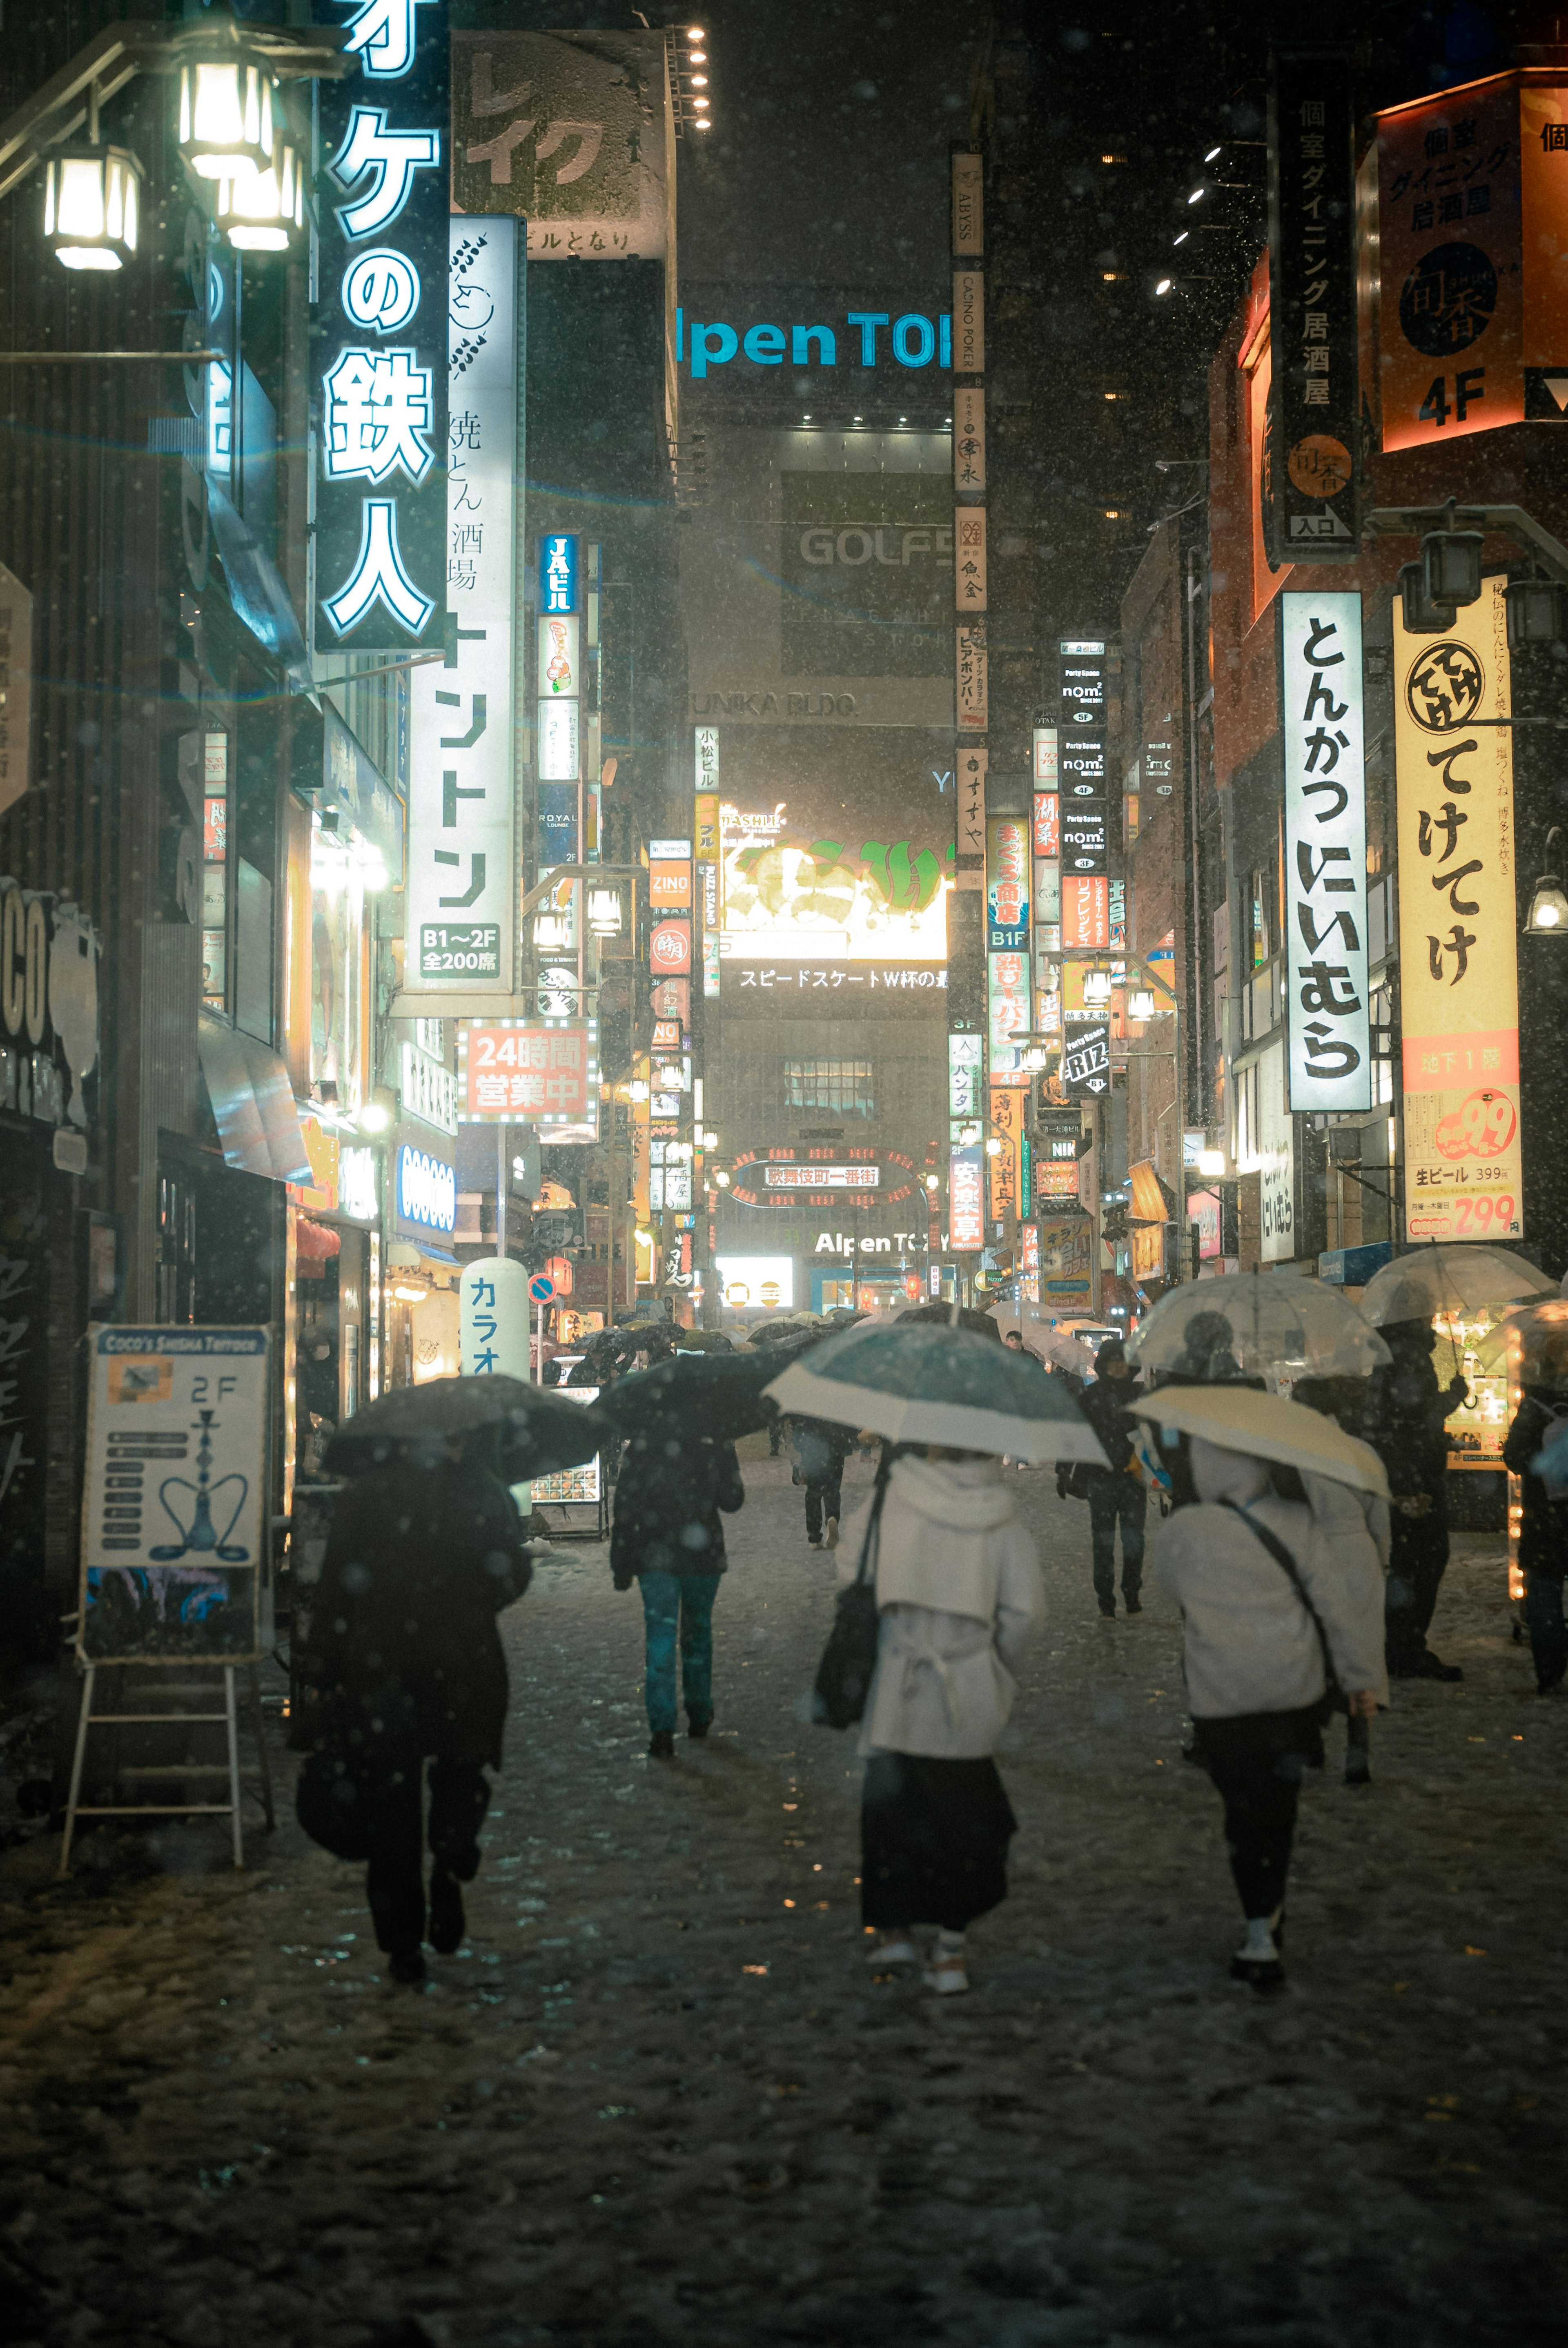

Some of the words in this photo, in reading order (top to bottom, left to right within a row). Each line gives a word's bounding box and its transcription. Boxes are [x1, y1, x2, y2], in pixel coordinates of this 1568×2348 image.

[1410, 184, 1490, 233] 居酒屋
[963, 277, 974, 325] CASINO
[963, 329, 974, 367] POKER
[1419, 366, 1486, 427] 4F
[1297, 522, 1335, 535] 入口
[961, 560, 983, 598] 魚金
[701, 730, 714, 787] 小松ビル
[566, 853, 576, 862] 2F
[1416, 738, 1483, 987] てけてけ
[653, 876, 688, 890] ZINO
[423, 952, 497, 971] 全200席
[954, 1019, 976, 1029] 3F
[1065, 1011, 1108, 1021] 博多天神
[475, 1036, 581, 1070] 24時間
[475, 1074, 579, 1107] 営業中
[1000, 1073, 1021, 1085] 4F
[951, 1146, 964, 1155] 2F
[768, 1169, 877, 1185] 歌舞伎町一番街
[1417, 1167, 1469, 1186] 生ビール
[953, 1161, 979, 1242] 安楽亭
[191, 1376, 238, 1403] 2F
